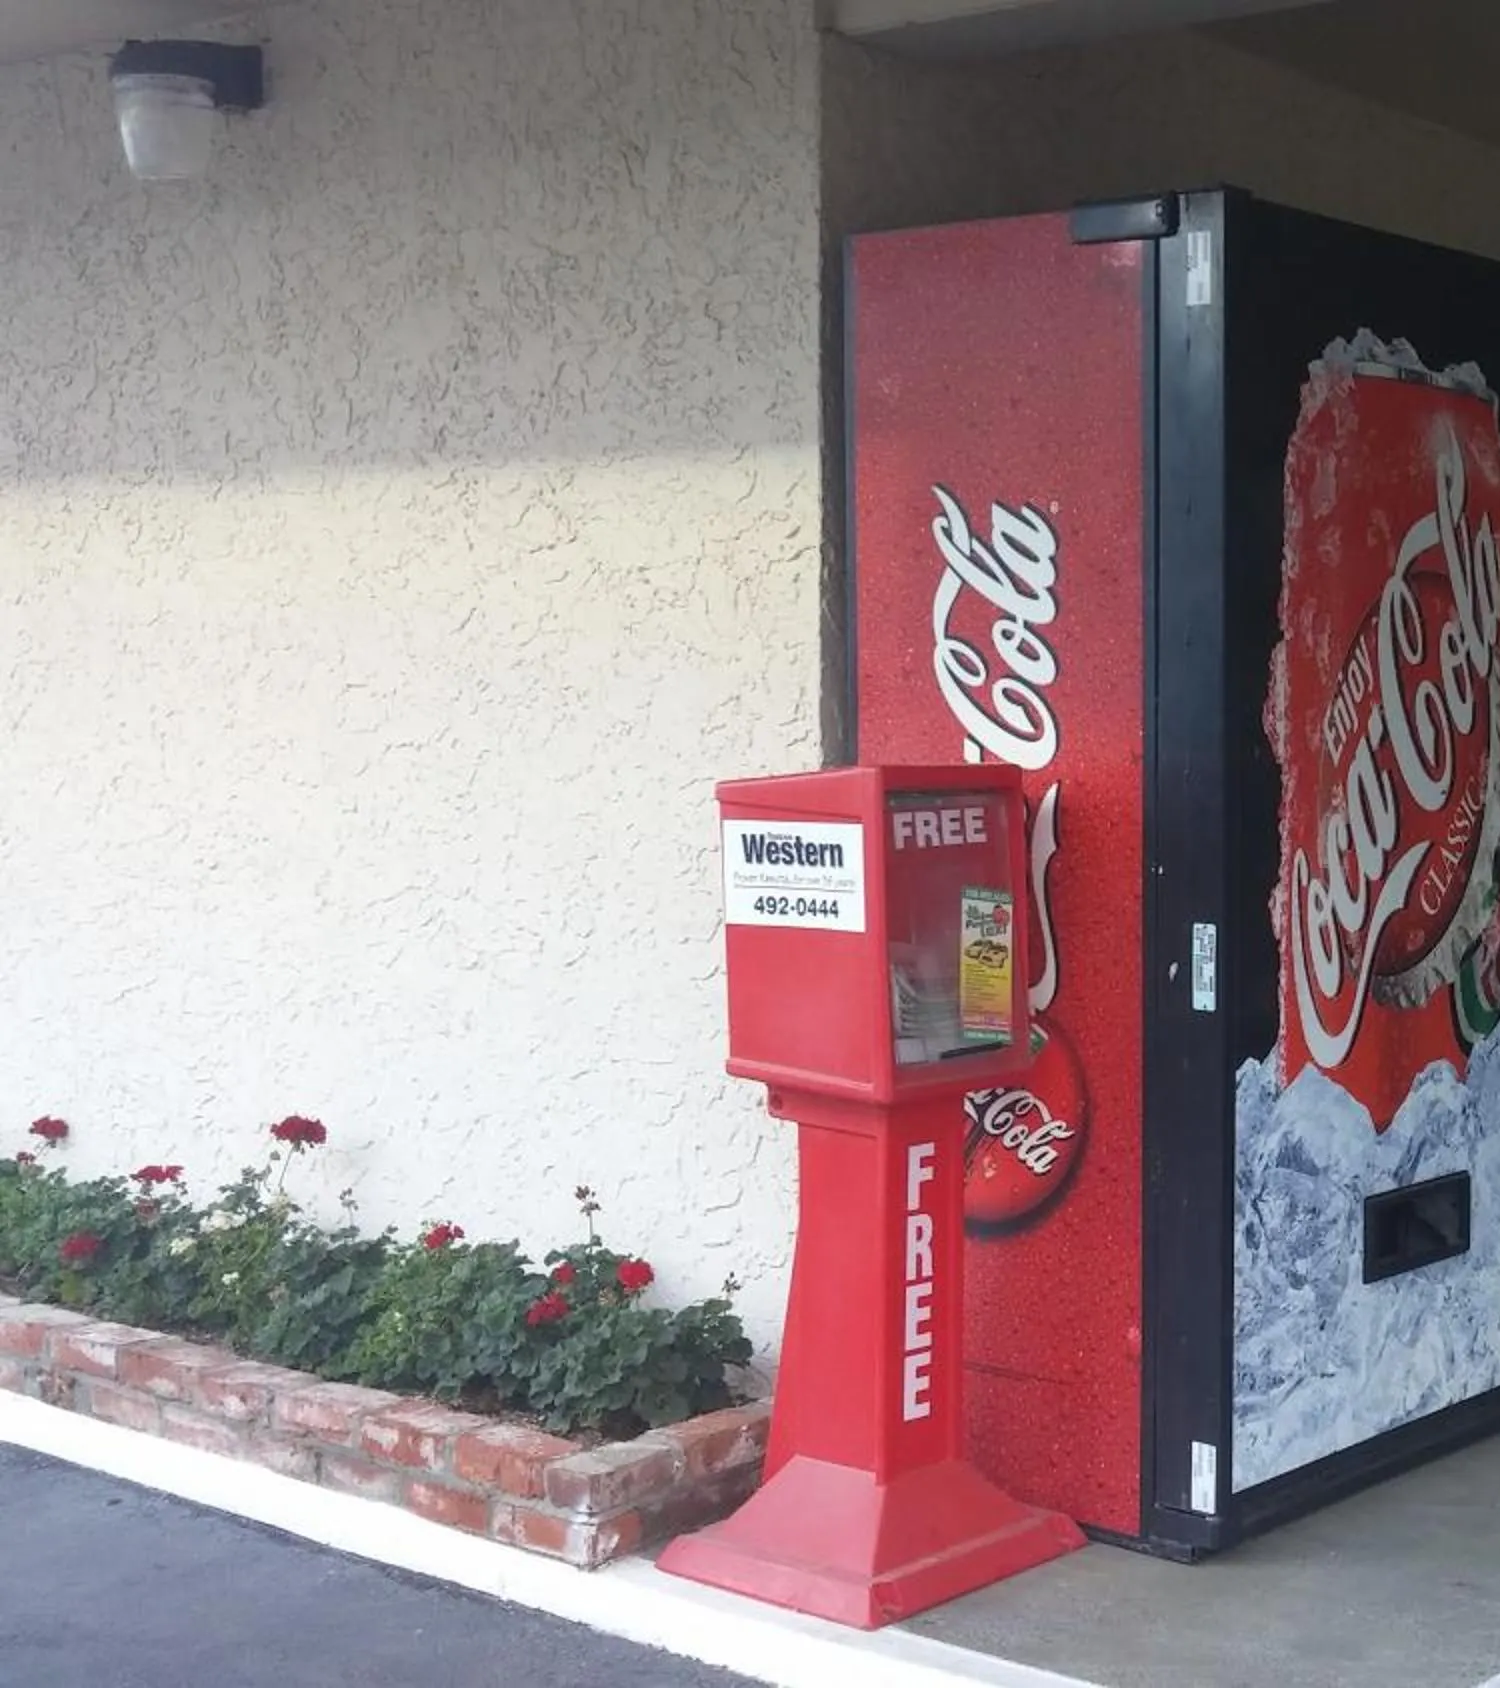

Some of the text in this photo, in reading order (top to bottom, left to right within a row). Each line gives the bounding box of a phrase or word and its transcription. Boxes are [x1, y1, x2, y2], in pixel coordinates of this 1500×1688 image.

[1322, 634, 1375, 767] Enjoy
[741, 832, 845, 869] Western
[892, 807, 989, 850] FREE
[1419, 776, 1485, 917] CLASSIC
[753, 894, 840, 919] 492-0444
[902, 1141, 936, 1422] FREE
